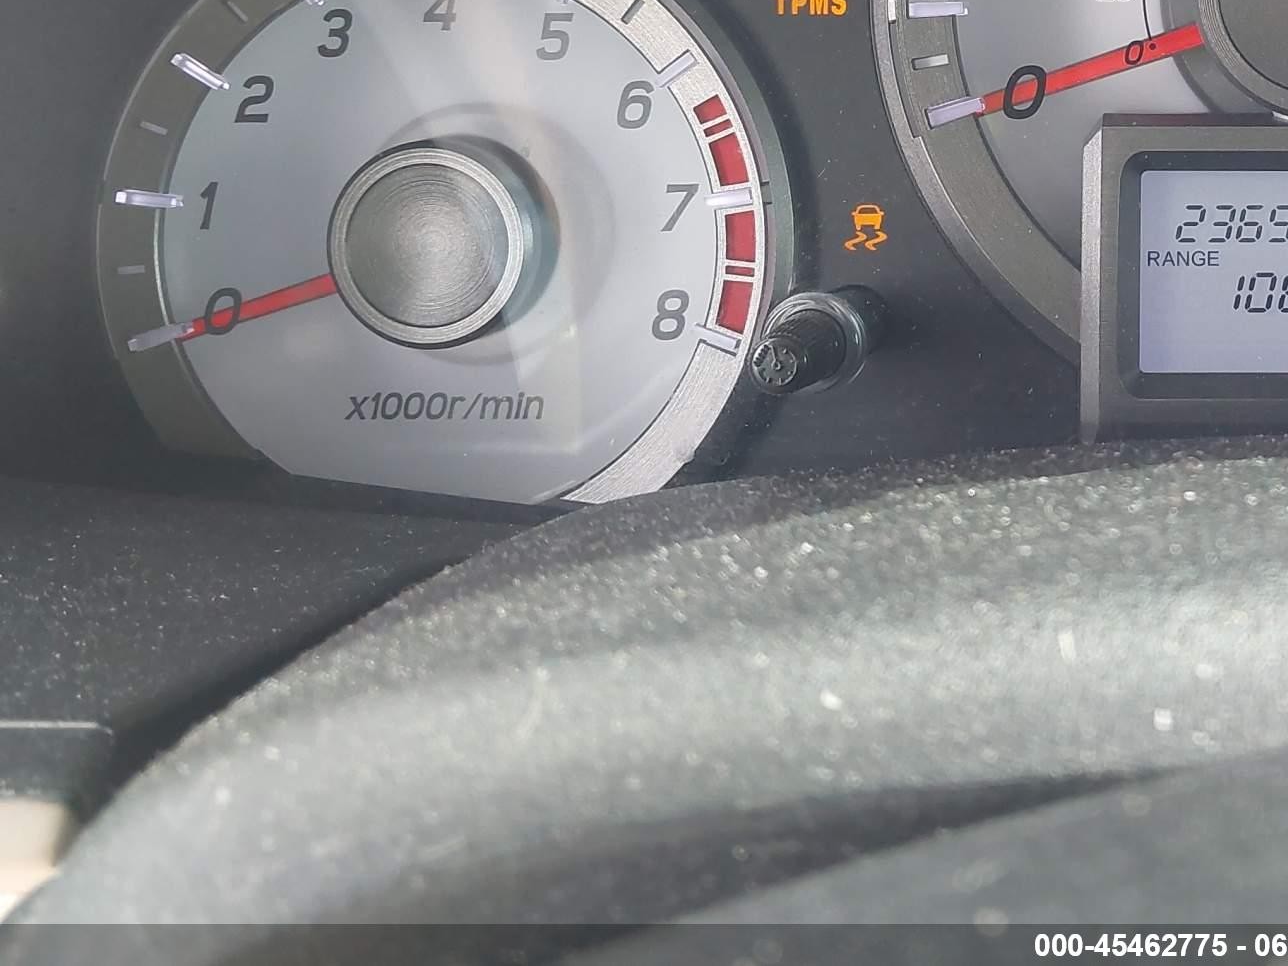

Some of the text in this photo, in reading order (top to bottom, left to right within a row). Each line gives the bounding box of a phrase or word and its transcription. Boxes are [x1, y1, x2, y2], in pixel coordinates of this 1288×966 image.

[318, 9, 353, 58] 3
[535, 12, 575, 61] 5
[1124, 40, 1144, 65] 0
[234, 75, 274, 124] 2
[617, 81, 654, 130] 6
[1003, 65, 1047, 119] 0
[199, 181, 219, 230] 1
[661, 183, 700, 233] 7
[1147, 250, 1220, 267] RANGE
[205, 288, 242, 335] 0
[652, 289, 690, 341] 8
[344, 391, 545, 424] x1000r/min
